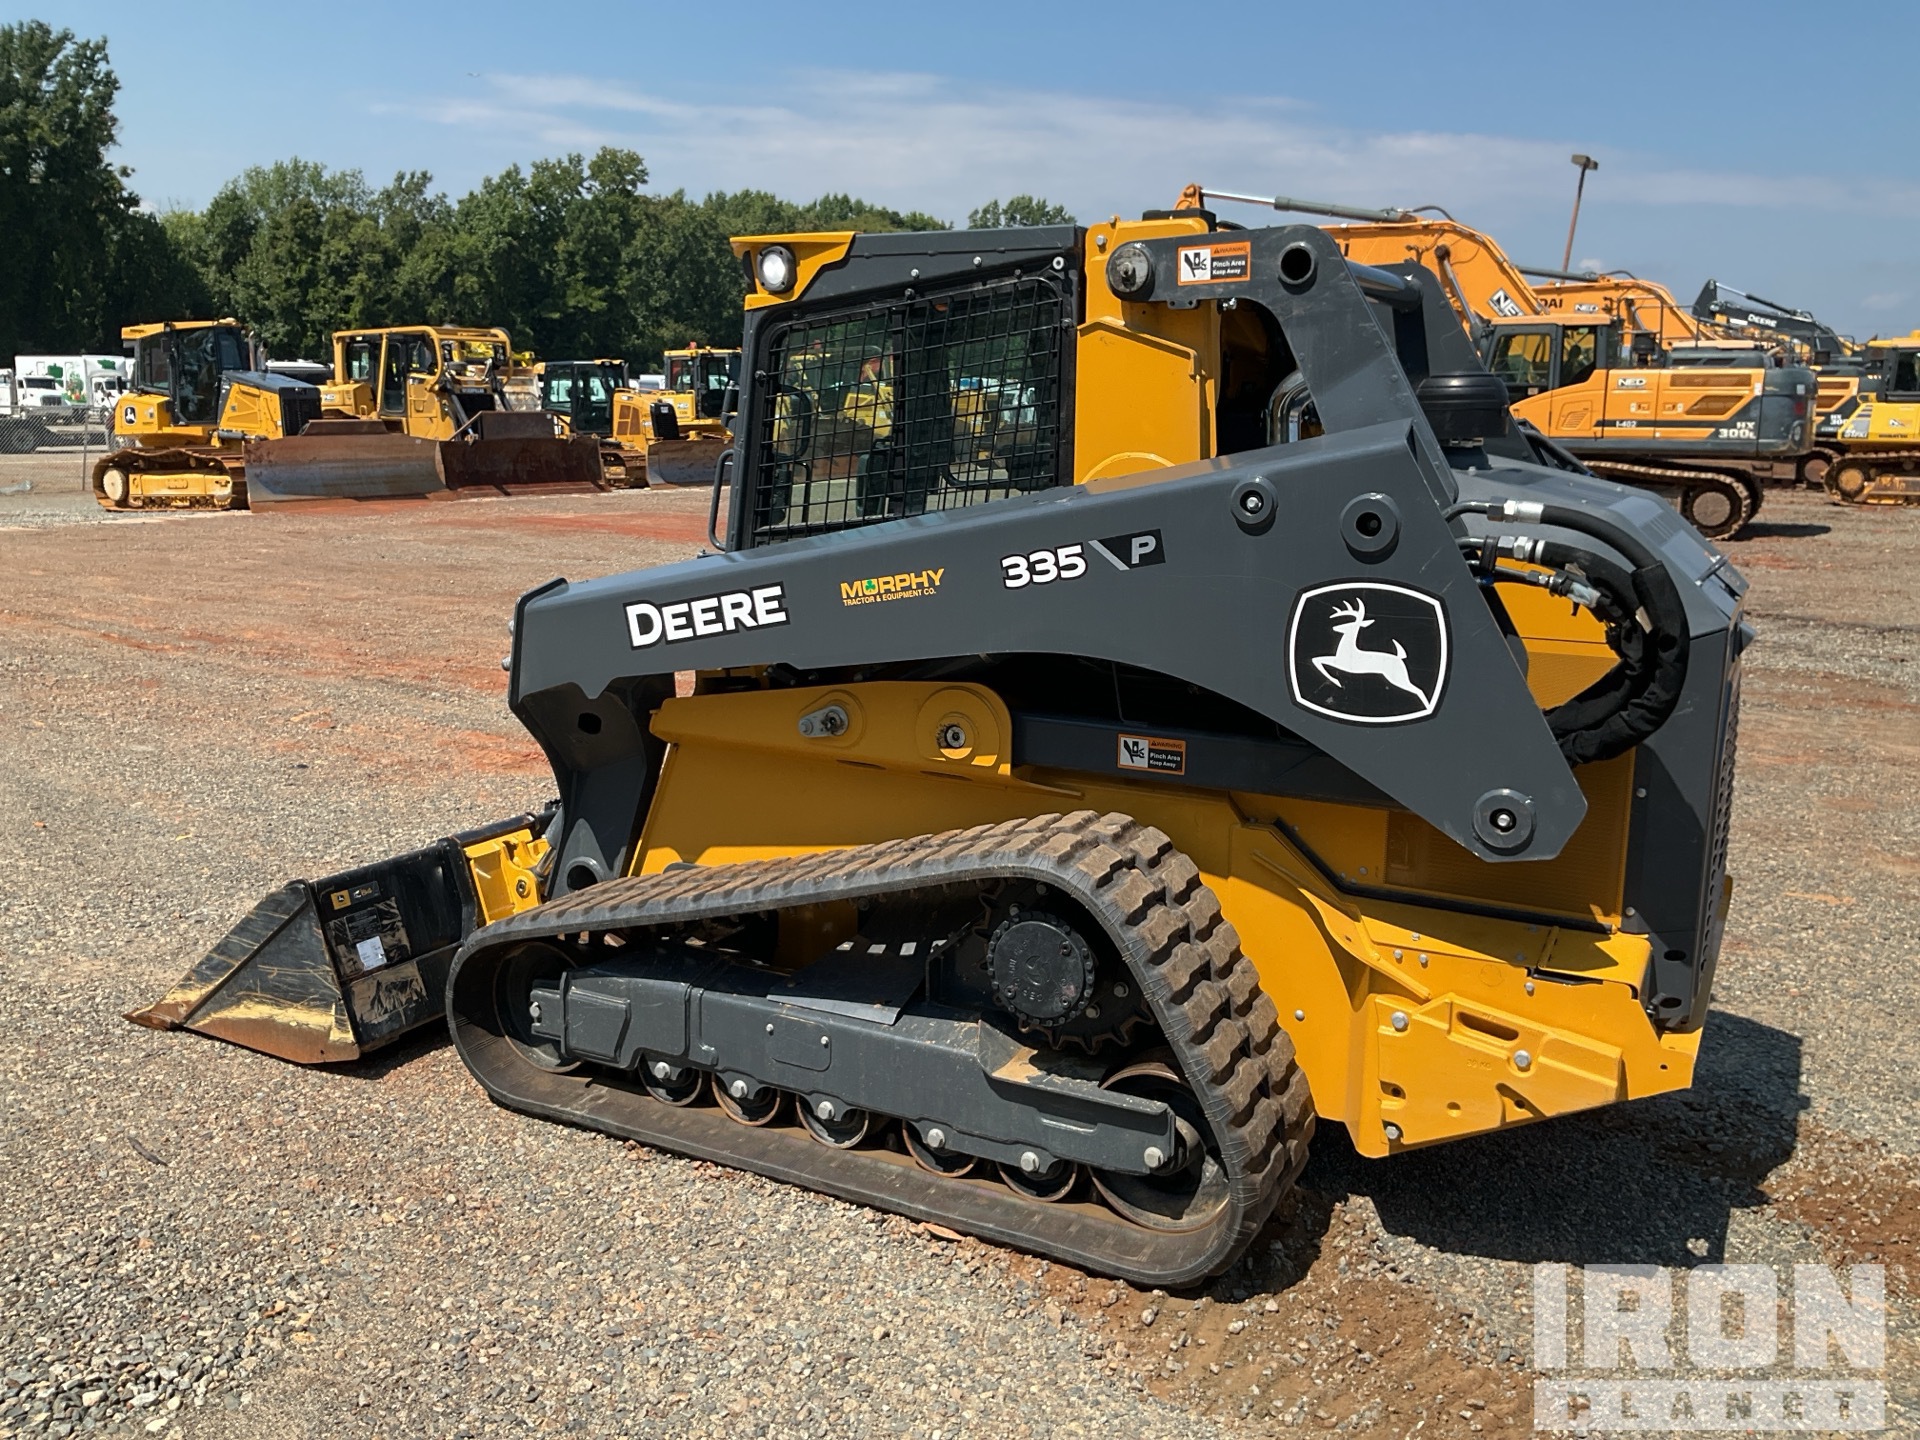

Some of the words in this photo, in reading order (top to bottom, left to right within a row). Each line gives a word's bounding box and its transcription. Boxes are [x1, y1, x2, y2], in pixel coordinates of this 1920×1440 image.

[1747, 313, 1778, 328] DEERE
[1736, 421, 1755, 430] HX
[1001, 544, 1087, 589] 335
[1130, 535, 1157, 565] P
[840, 568, 945, 599] MURPHY
[842, 596, 875, 607] TRACTOR
[876, 594, 882, 602] &
[882, 589, 923, 602] EQUIPMENT
[923, 587, 937, 596] CO.
[625, 584, 788, 648] DEERE
[1149, 752, 1166, 760] Pinch
